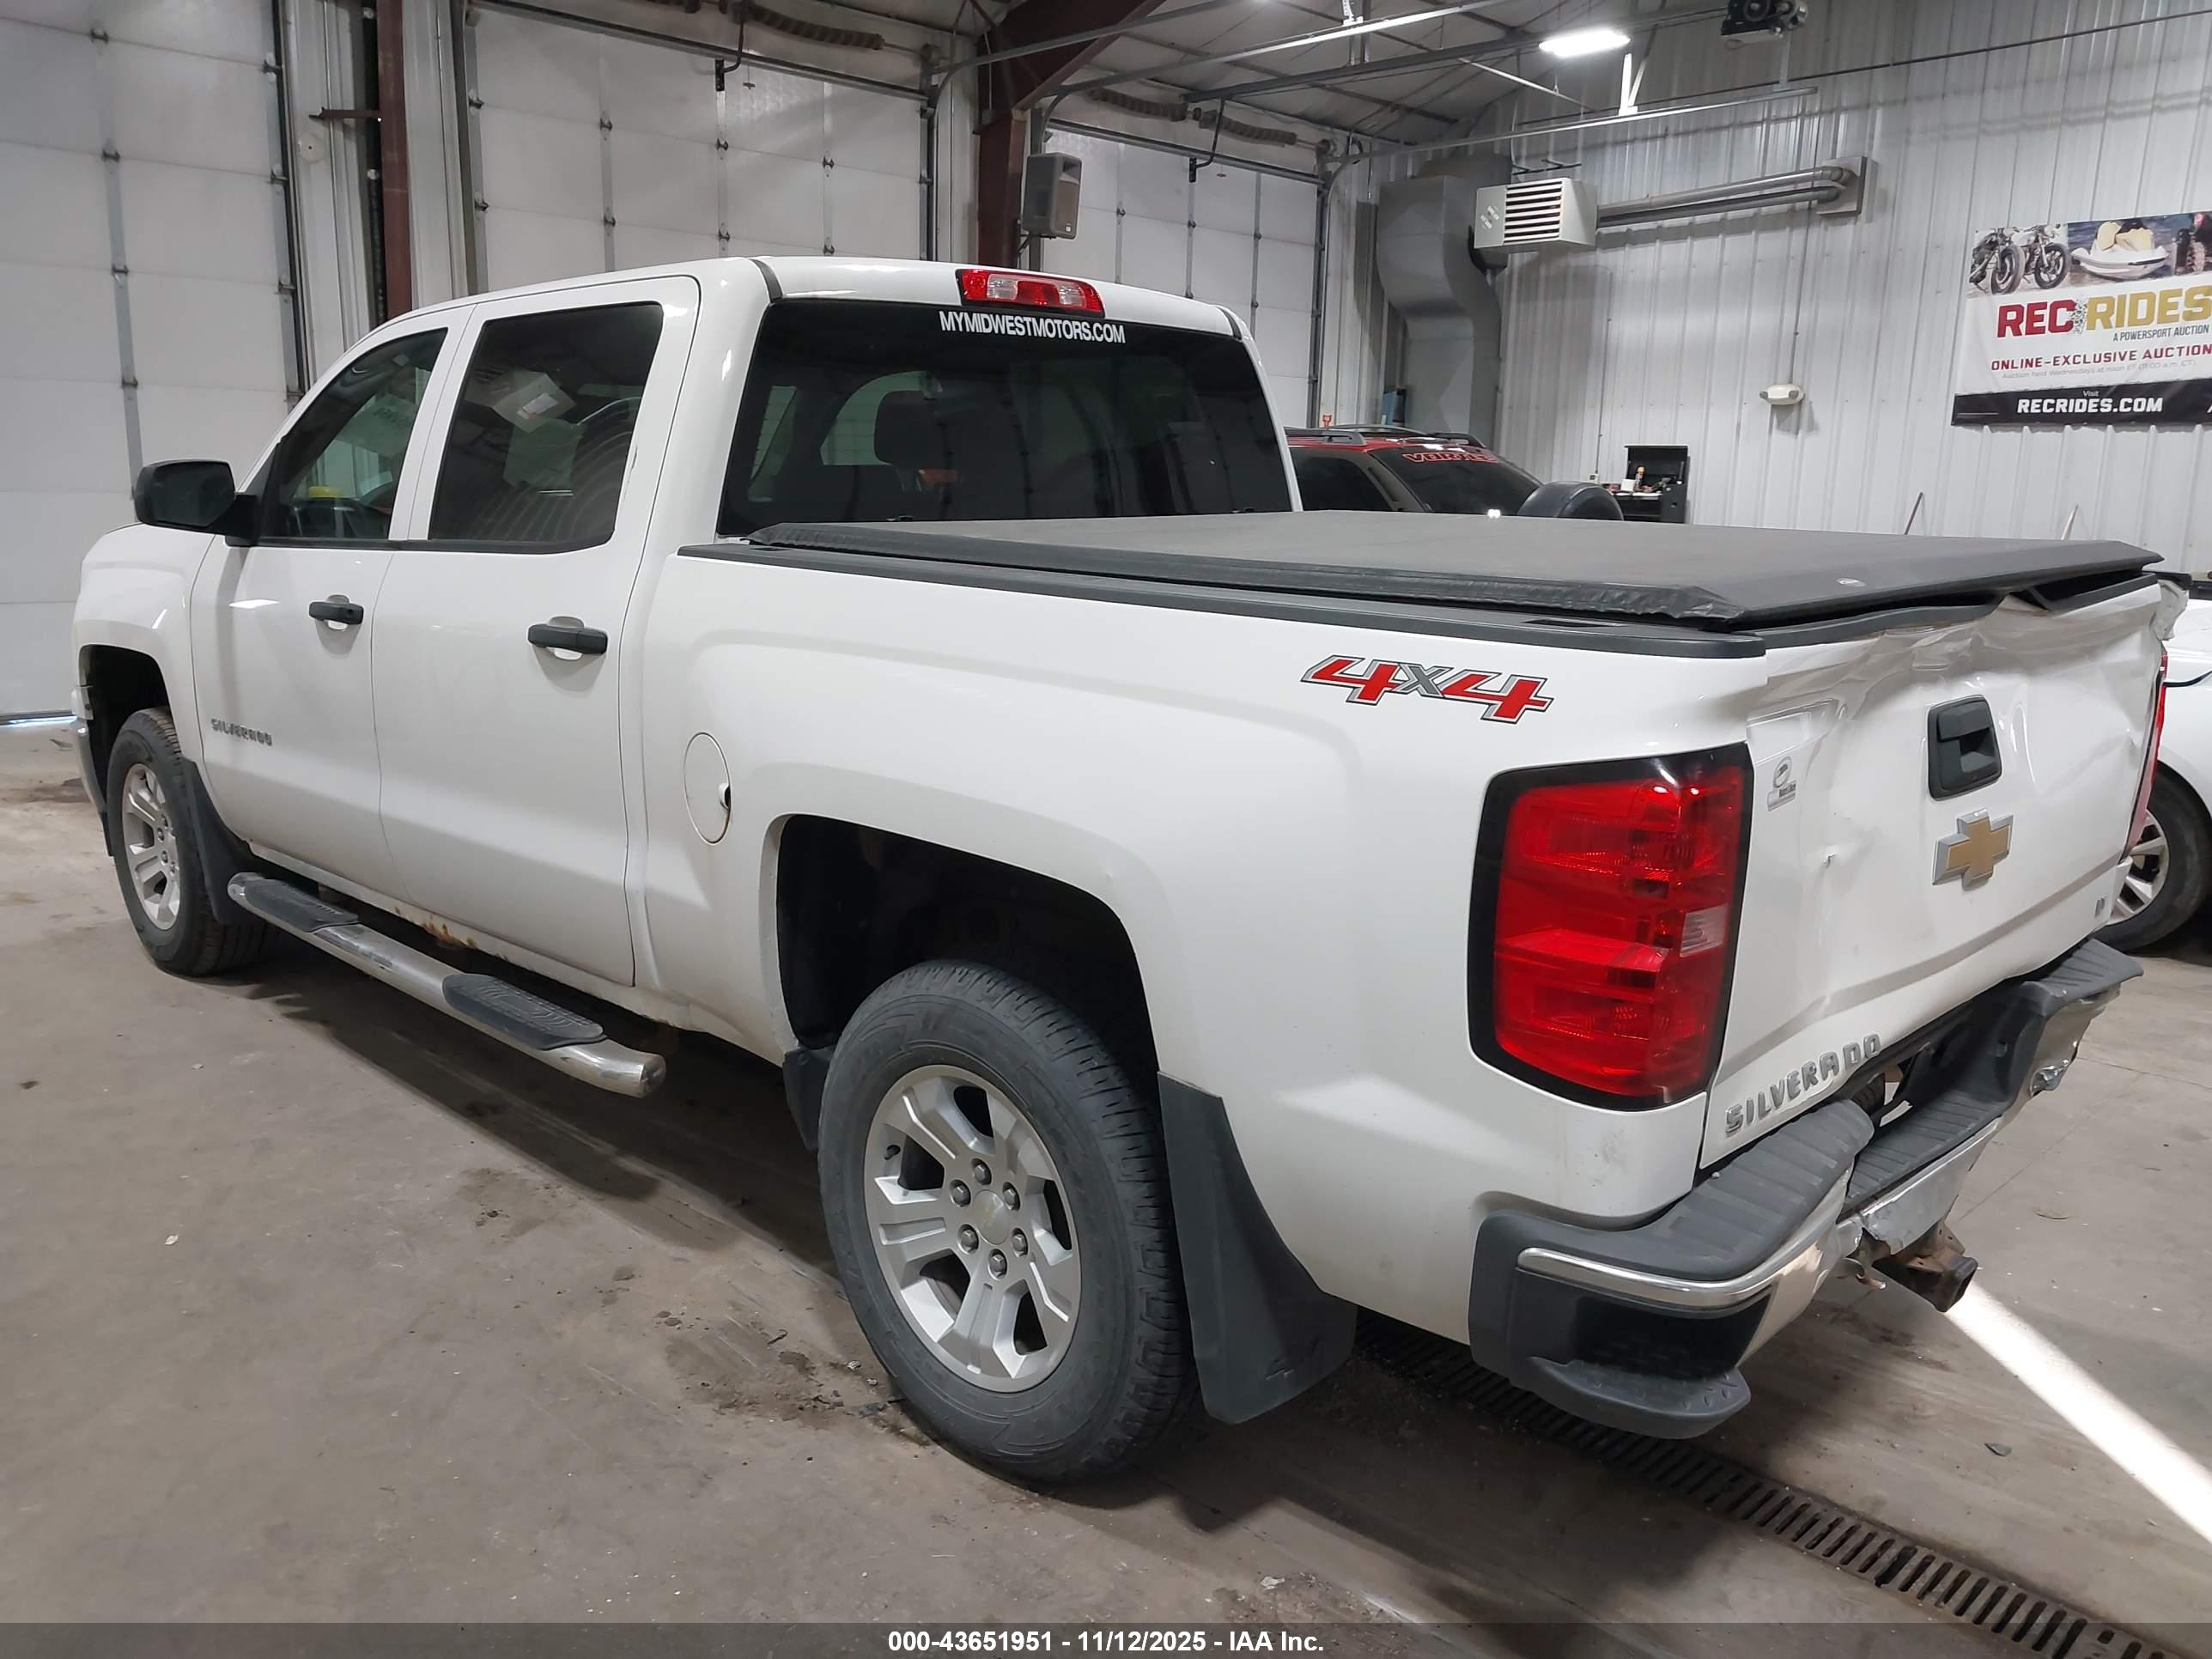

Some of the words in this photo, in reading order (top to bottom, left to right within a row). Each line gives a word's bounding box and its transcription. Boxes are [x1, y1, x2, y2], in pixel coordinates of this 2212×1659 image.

[1997, 299, 2077, 338] REC
[2085, 284, 2212, 331] RIDES
[939, 310, 1126, 343] MYMIDWESTMOTORS.COM
[2112, 332, 2118, 342] A
[2119, 327, 2172, 341] POWERSPORT
[2173, 324, 2210, 337] AUCTION
[1990, 350, 2138, 371] ONLINE-EXCLUSIVE
[2016, 397, 2164, 413] RECRIDES.COM
[1725, 1032, 1881, 1134] SILVERADO
